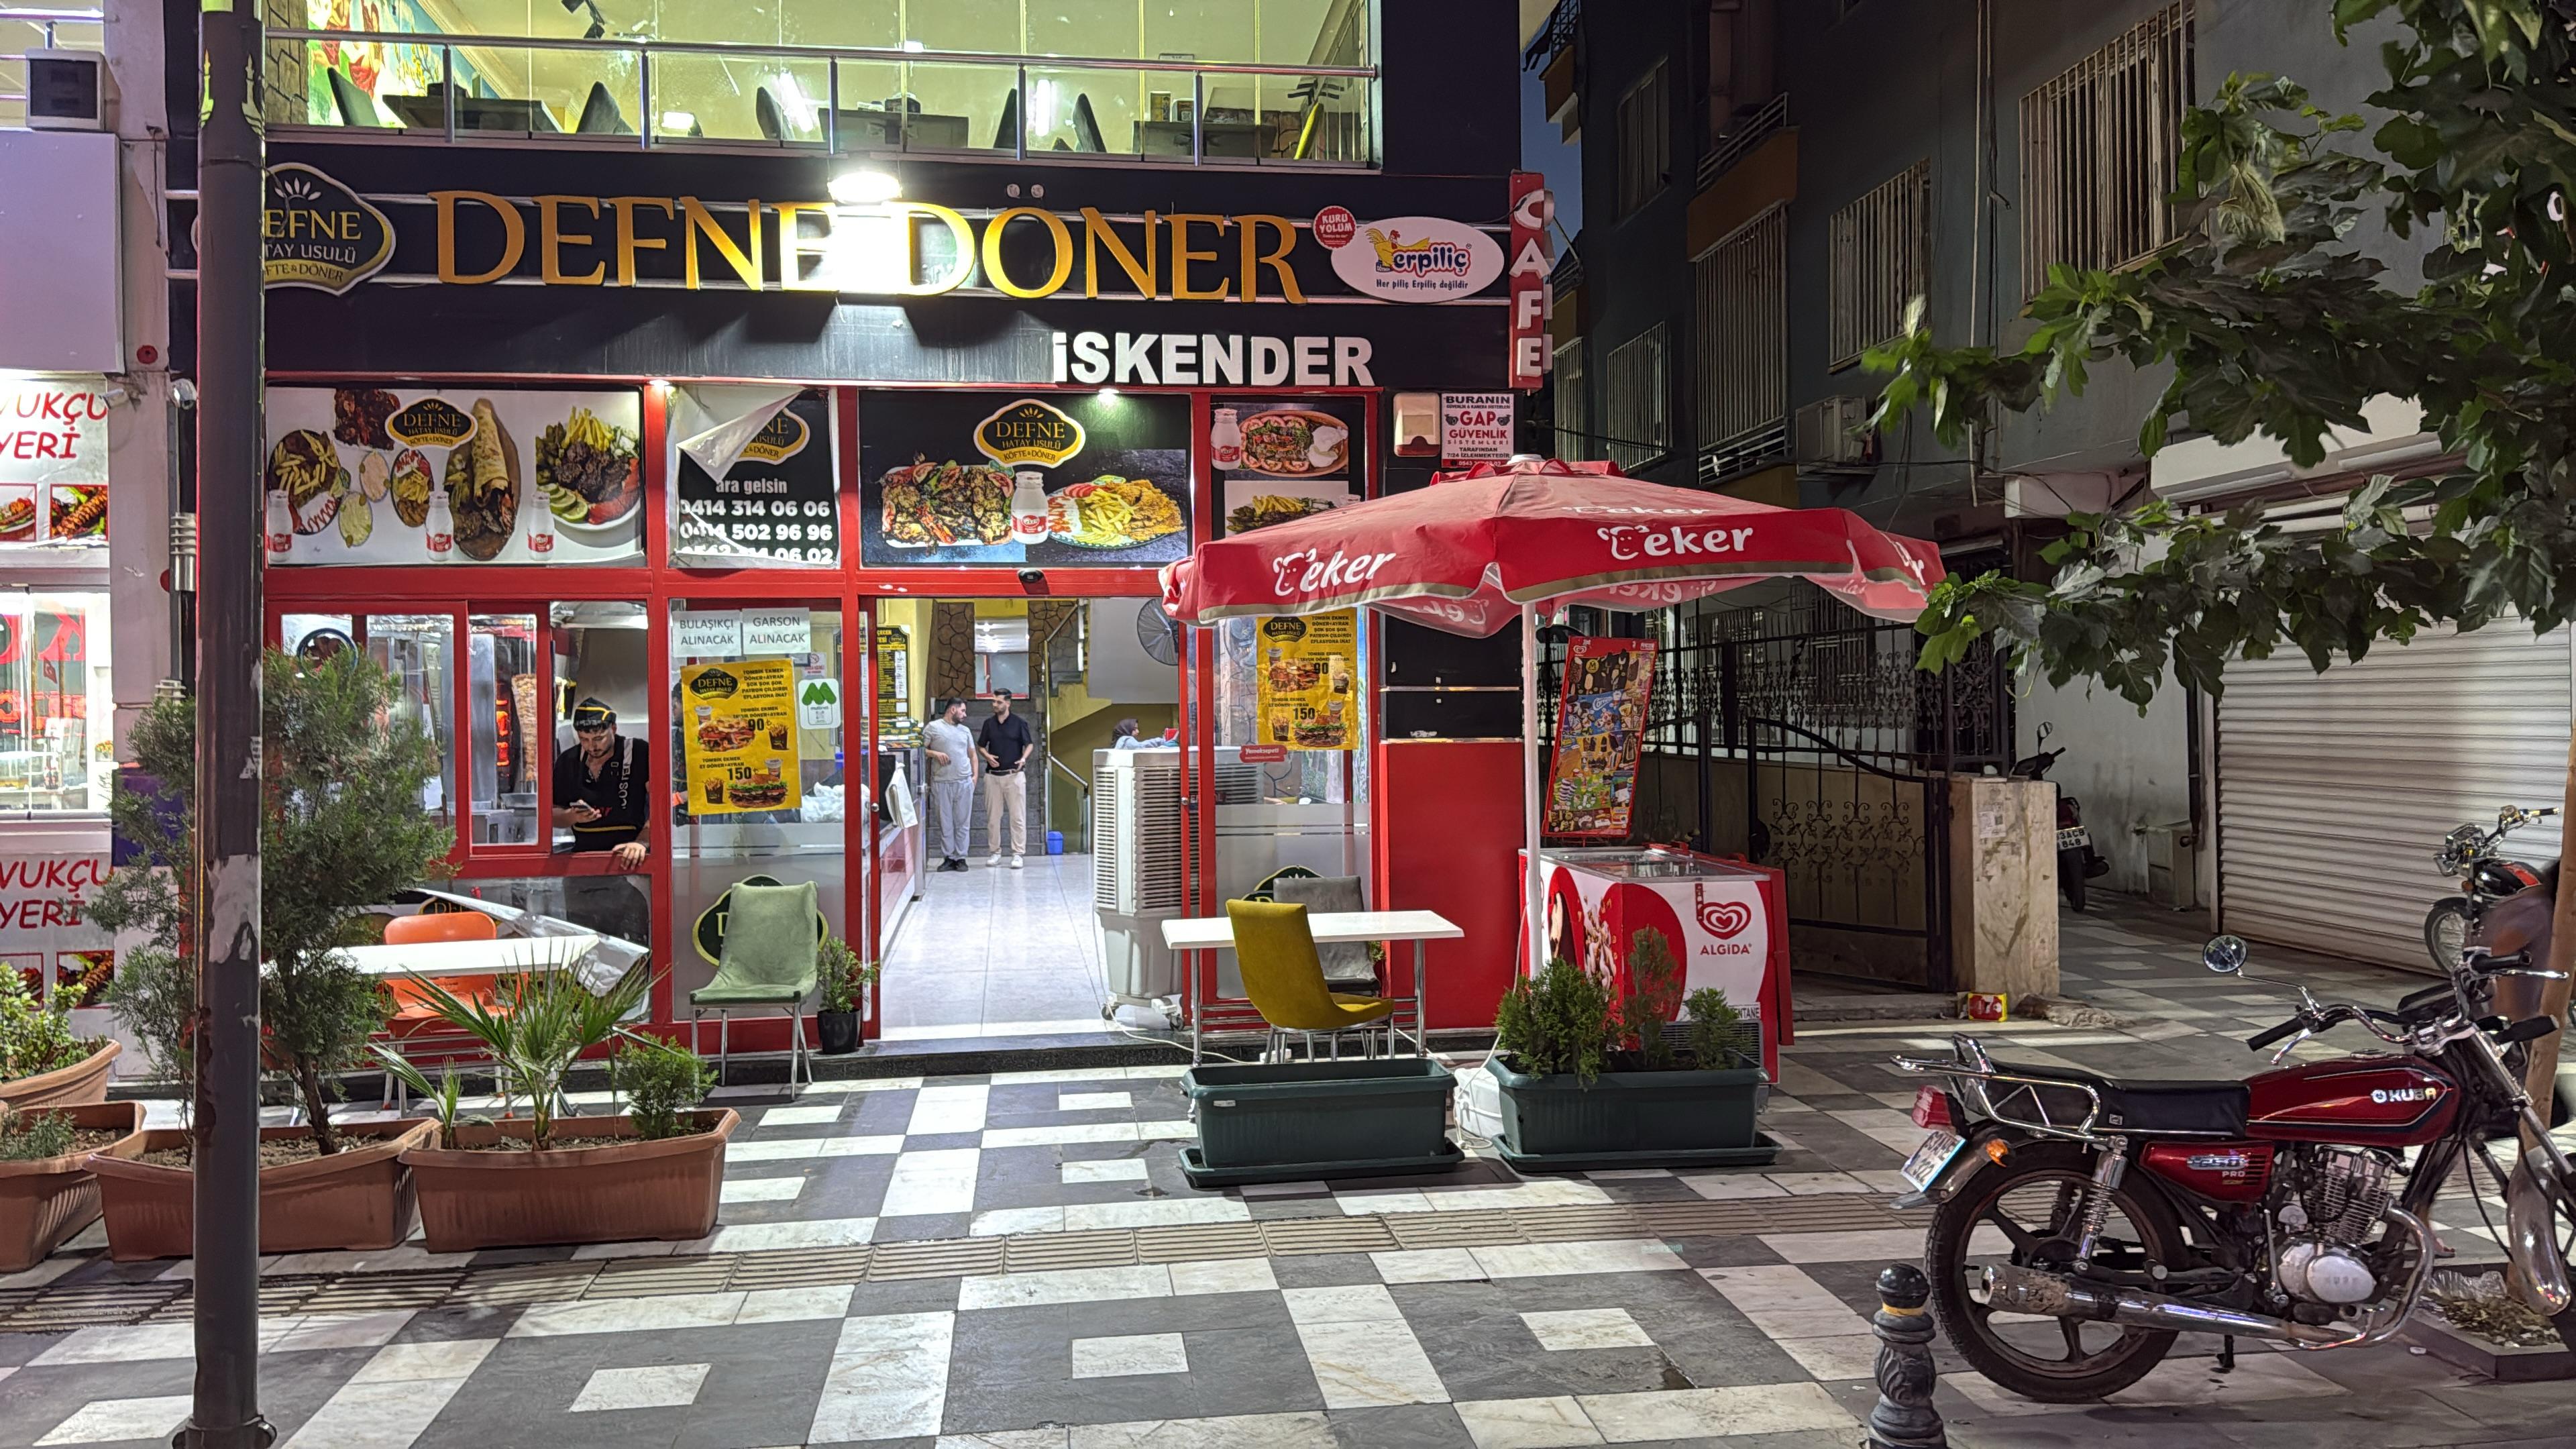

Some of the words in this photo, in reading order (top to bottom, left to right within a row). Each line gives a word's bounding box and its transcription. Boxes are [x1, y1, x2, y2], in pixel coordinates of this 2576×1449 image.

[264, 209, 362, 239] EFNE
[1322, 213, 1348, 224] KURU
[1319, 222, 1353, 233] YOLUM
[427, 190, 839, 292] DEFNE
[885, 183, 1307, 305] DÖNER
[265, 244, 294, 258] TAY
[301, 244, 356, 264] USULÜ
[299, 262, 343, 283] DÖNER
[1376, 278, 1389, 288] Her
[1392, 279, 1409, 290] piliç
[1412, 279, 1437, 290] Erpiliç
[1439, 279, 1468, 290] değildir
[1509, 189, 1552, 377] CAFE
[1446, 396, 1510, 404] BURANIN
[1460, 411, 1497, 426] GAP
[996, 421, 1065, 439] DEFNE
[1449, 427, 1508, 439] GÜVENLİK
[1002, 438, 1030, 449] HATAY
[1032, 449, 1057, 462] DÖNER
[716, 480, 739, 493] ara
[743, 478, 788, 494] gelsin
[680, 499, 727, 517] 0414
[731, 500, 766, 517] 314
[771, 500, 798, 517] 06
[803, 501, 830, 517] 06
[732, 524, 771, 541] 502
[775, 524, 802, 541] 96
[807, 524, 833, 541] 96
[680, 619, 734, 631] BULAŞIKÇI
[753, 616, 800, 627] GARSON
[1271, 622, 1302, 631] DEFNE
[681, 635, 734, 645] ALINACAK
[749, 633, 805, 645] ALINACAK
[698, 677, 733, 688] DEFNE
[1293, 707, 1315, 720] 150
[747, 718, 765, 731] 90
[1245, 747, 1279, 755] Yemeksepeti
[727, 766, 752, 780] 150
[0, 893, 86, 929] YERİ
[2388, 1087, 2437, 1102] KUBA
